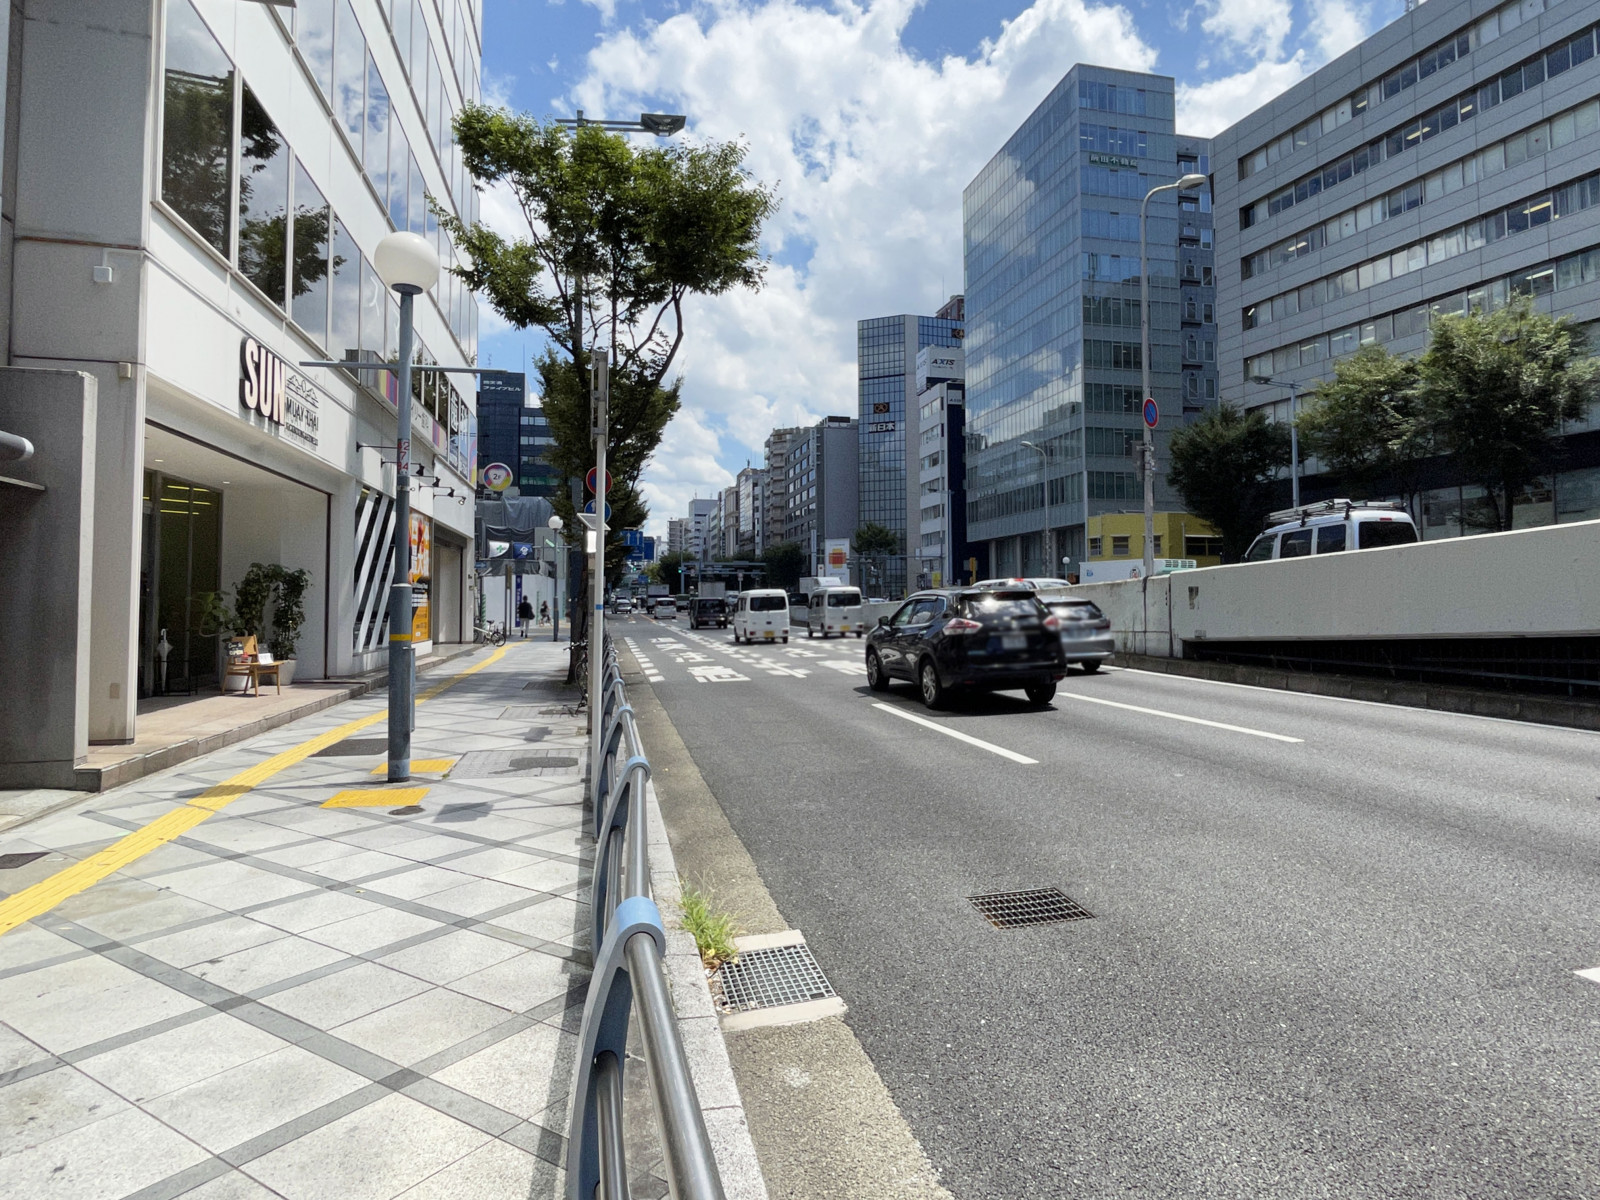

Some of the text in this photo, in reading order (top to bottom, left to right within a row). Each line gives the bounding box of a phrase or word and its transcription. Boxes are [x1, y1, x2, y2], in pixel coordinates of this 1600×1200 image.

[931, 358, 955, 366] AXIS
[240, 336, 286, 427] SUN
[286, 397, 319, 431] MUAY THAI
[869, 422, 895, 432] 新日本
